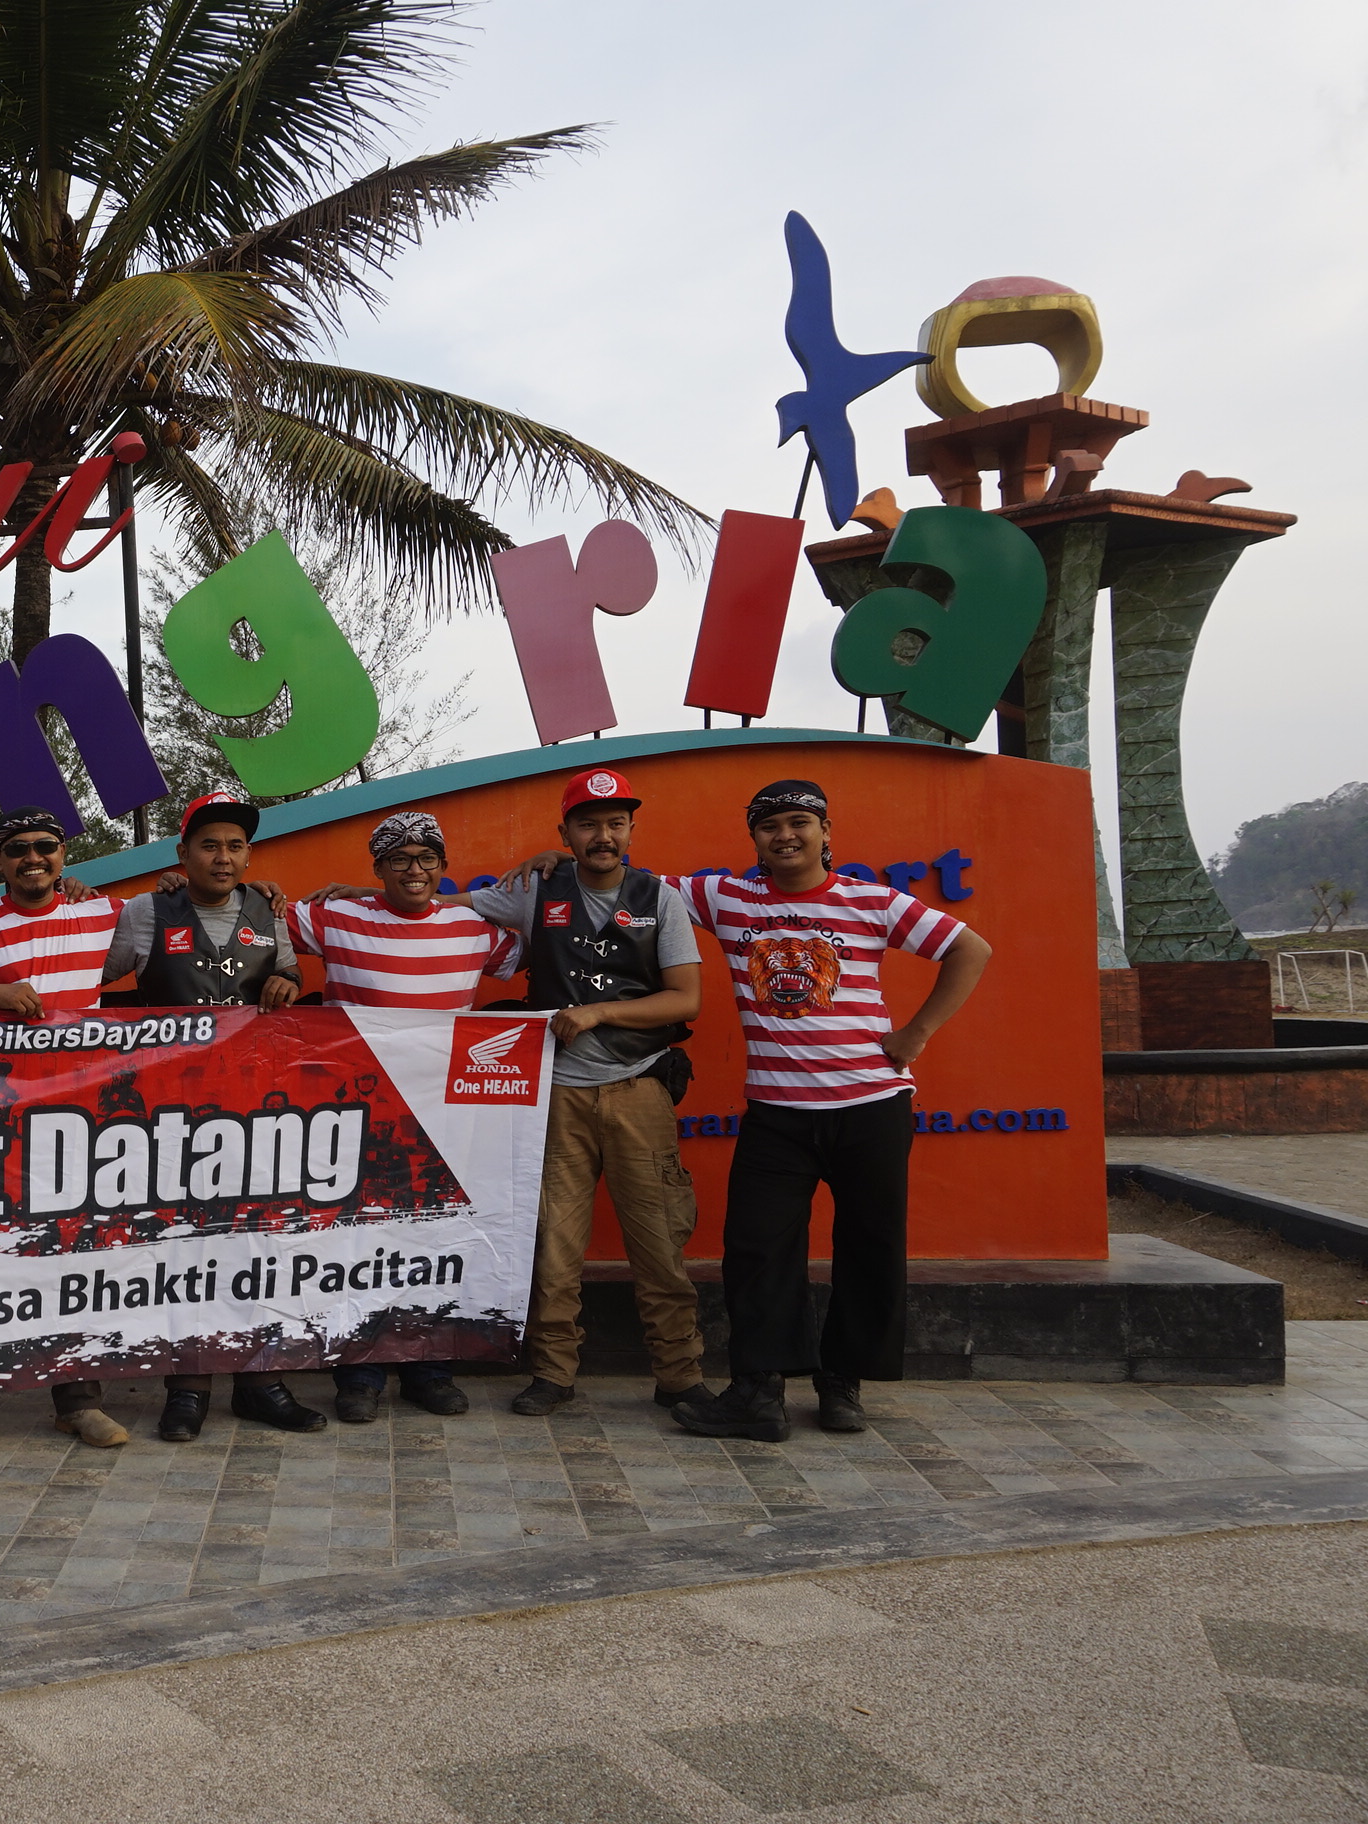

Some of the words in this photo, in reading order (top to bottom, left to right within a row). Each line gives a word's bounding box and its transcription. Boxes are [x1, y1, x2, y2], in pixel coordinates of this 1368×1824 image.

[734, 923, 763, 957] REOG
[766, 914, 852, 960] PONOROGO
[453, 1078, 480, 1094] One
[483, 1079, 529, 1095] HEART.
[465, 1064, 522, 1074] HONDA
[30, 1109, 364, 1214] Datang
[59, 1260, 217, 1317] Bhakti
[231, 1256, 277, 1301] di
[291, 1249, 464, 1296] Pacitan
